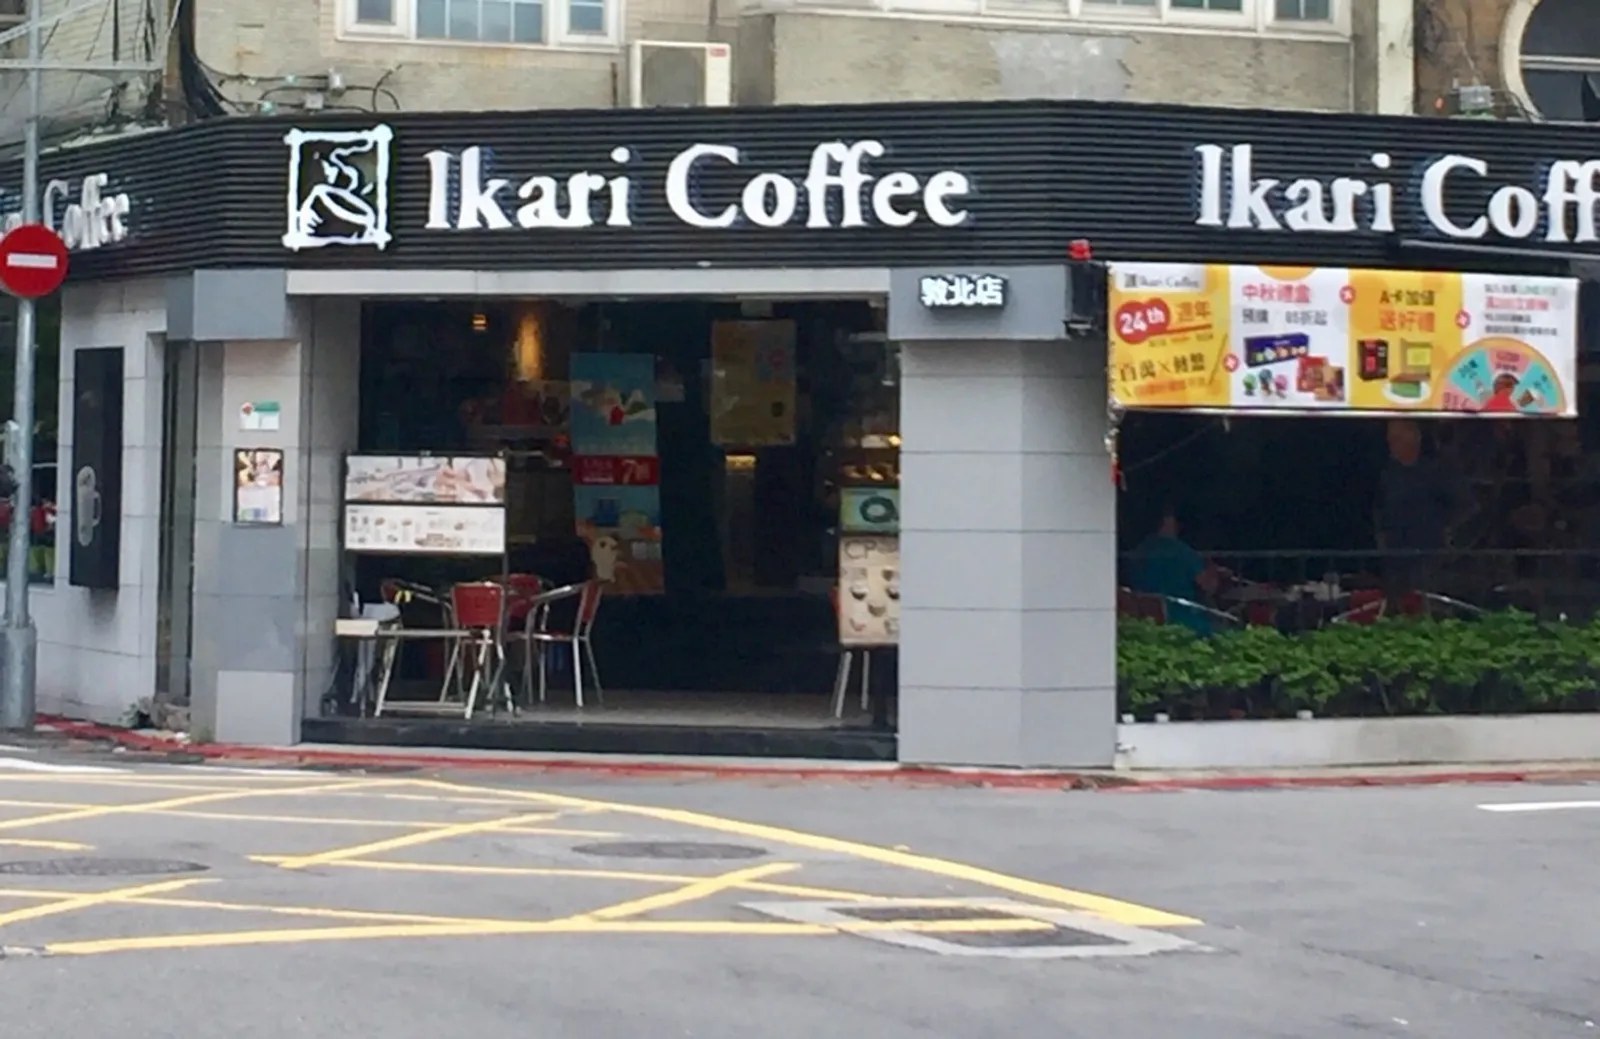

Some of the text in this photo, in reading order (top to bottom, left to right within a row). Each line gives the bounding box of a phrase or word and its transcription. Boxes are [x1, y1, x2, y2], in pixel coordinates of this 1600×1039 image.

[423, 140, 970, 229] Ikari Coffee
[1194, 143, 1395, 233] Ikari
[921, 276, 1003, 306] 敦北店
[1242, 283, 1311, 304] 中秋禮盒
